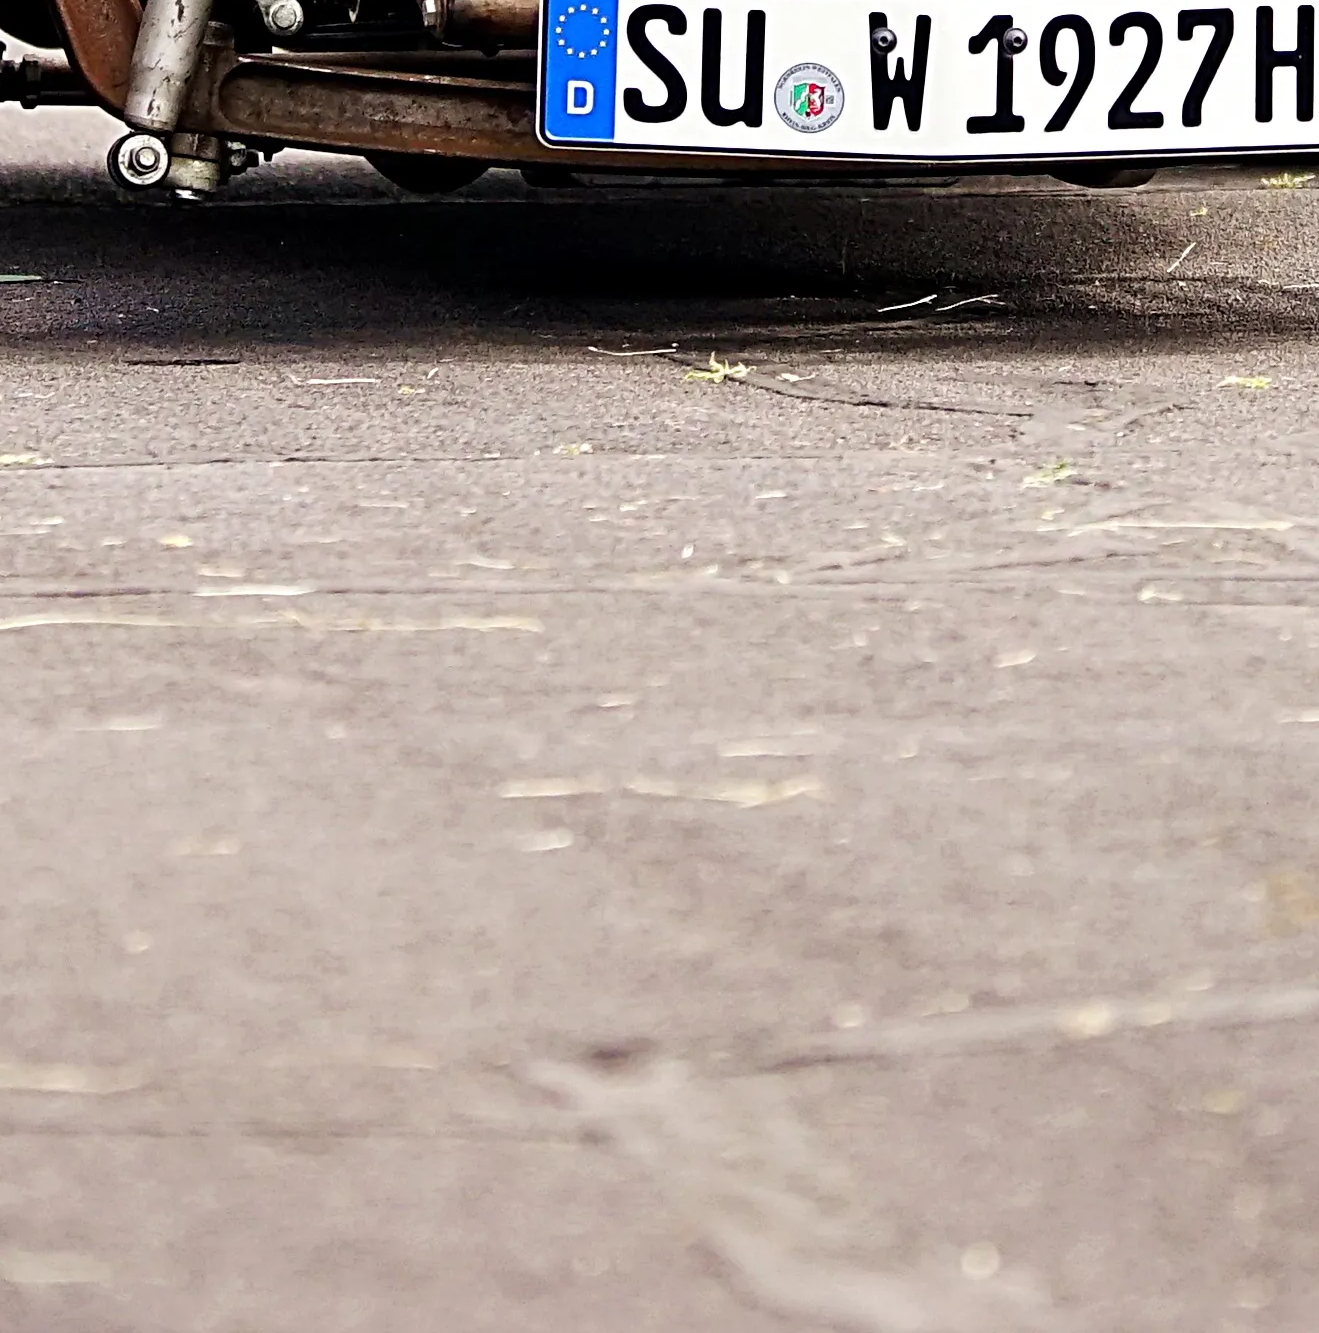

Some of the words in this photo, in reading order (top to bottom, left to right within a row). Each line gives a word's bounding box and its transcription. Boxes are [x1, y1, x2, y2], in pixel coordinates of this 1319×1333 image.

[566, 79, 595, 115] D
[623, 3, 766, 128] SU
[868, 11, 932, 132] W
[966, 4, 1315, 134] 1927H
